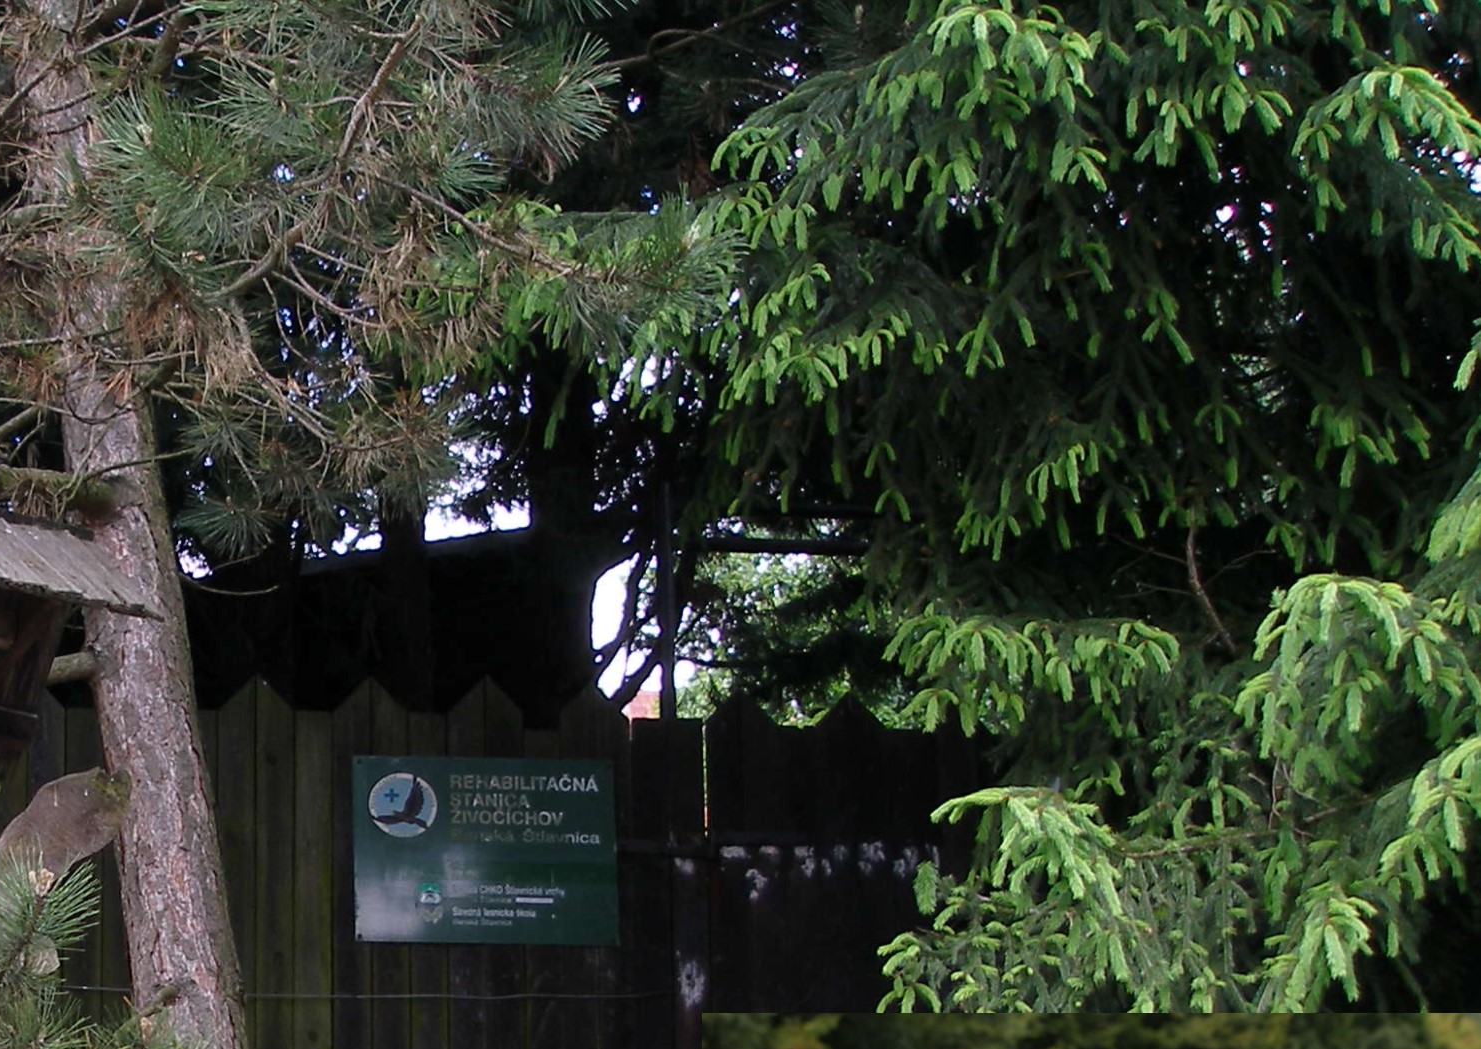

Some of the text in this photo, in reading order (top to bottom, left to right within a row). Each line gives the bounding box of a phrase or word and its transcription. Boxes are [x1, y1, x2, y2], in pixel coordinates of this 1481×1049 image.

[449, 773, 599, 792] REHABILITAČNÁ
[450, 793, 530, 808] STANICA
[450, 806, 564, 826] ŽIVOČÍCHOV
